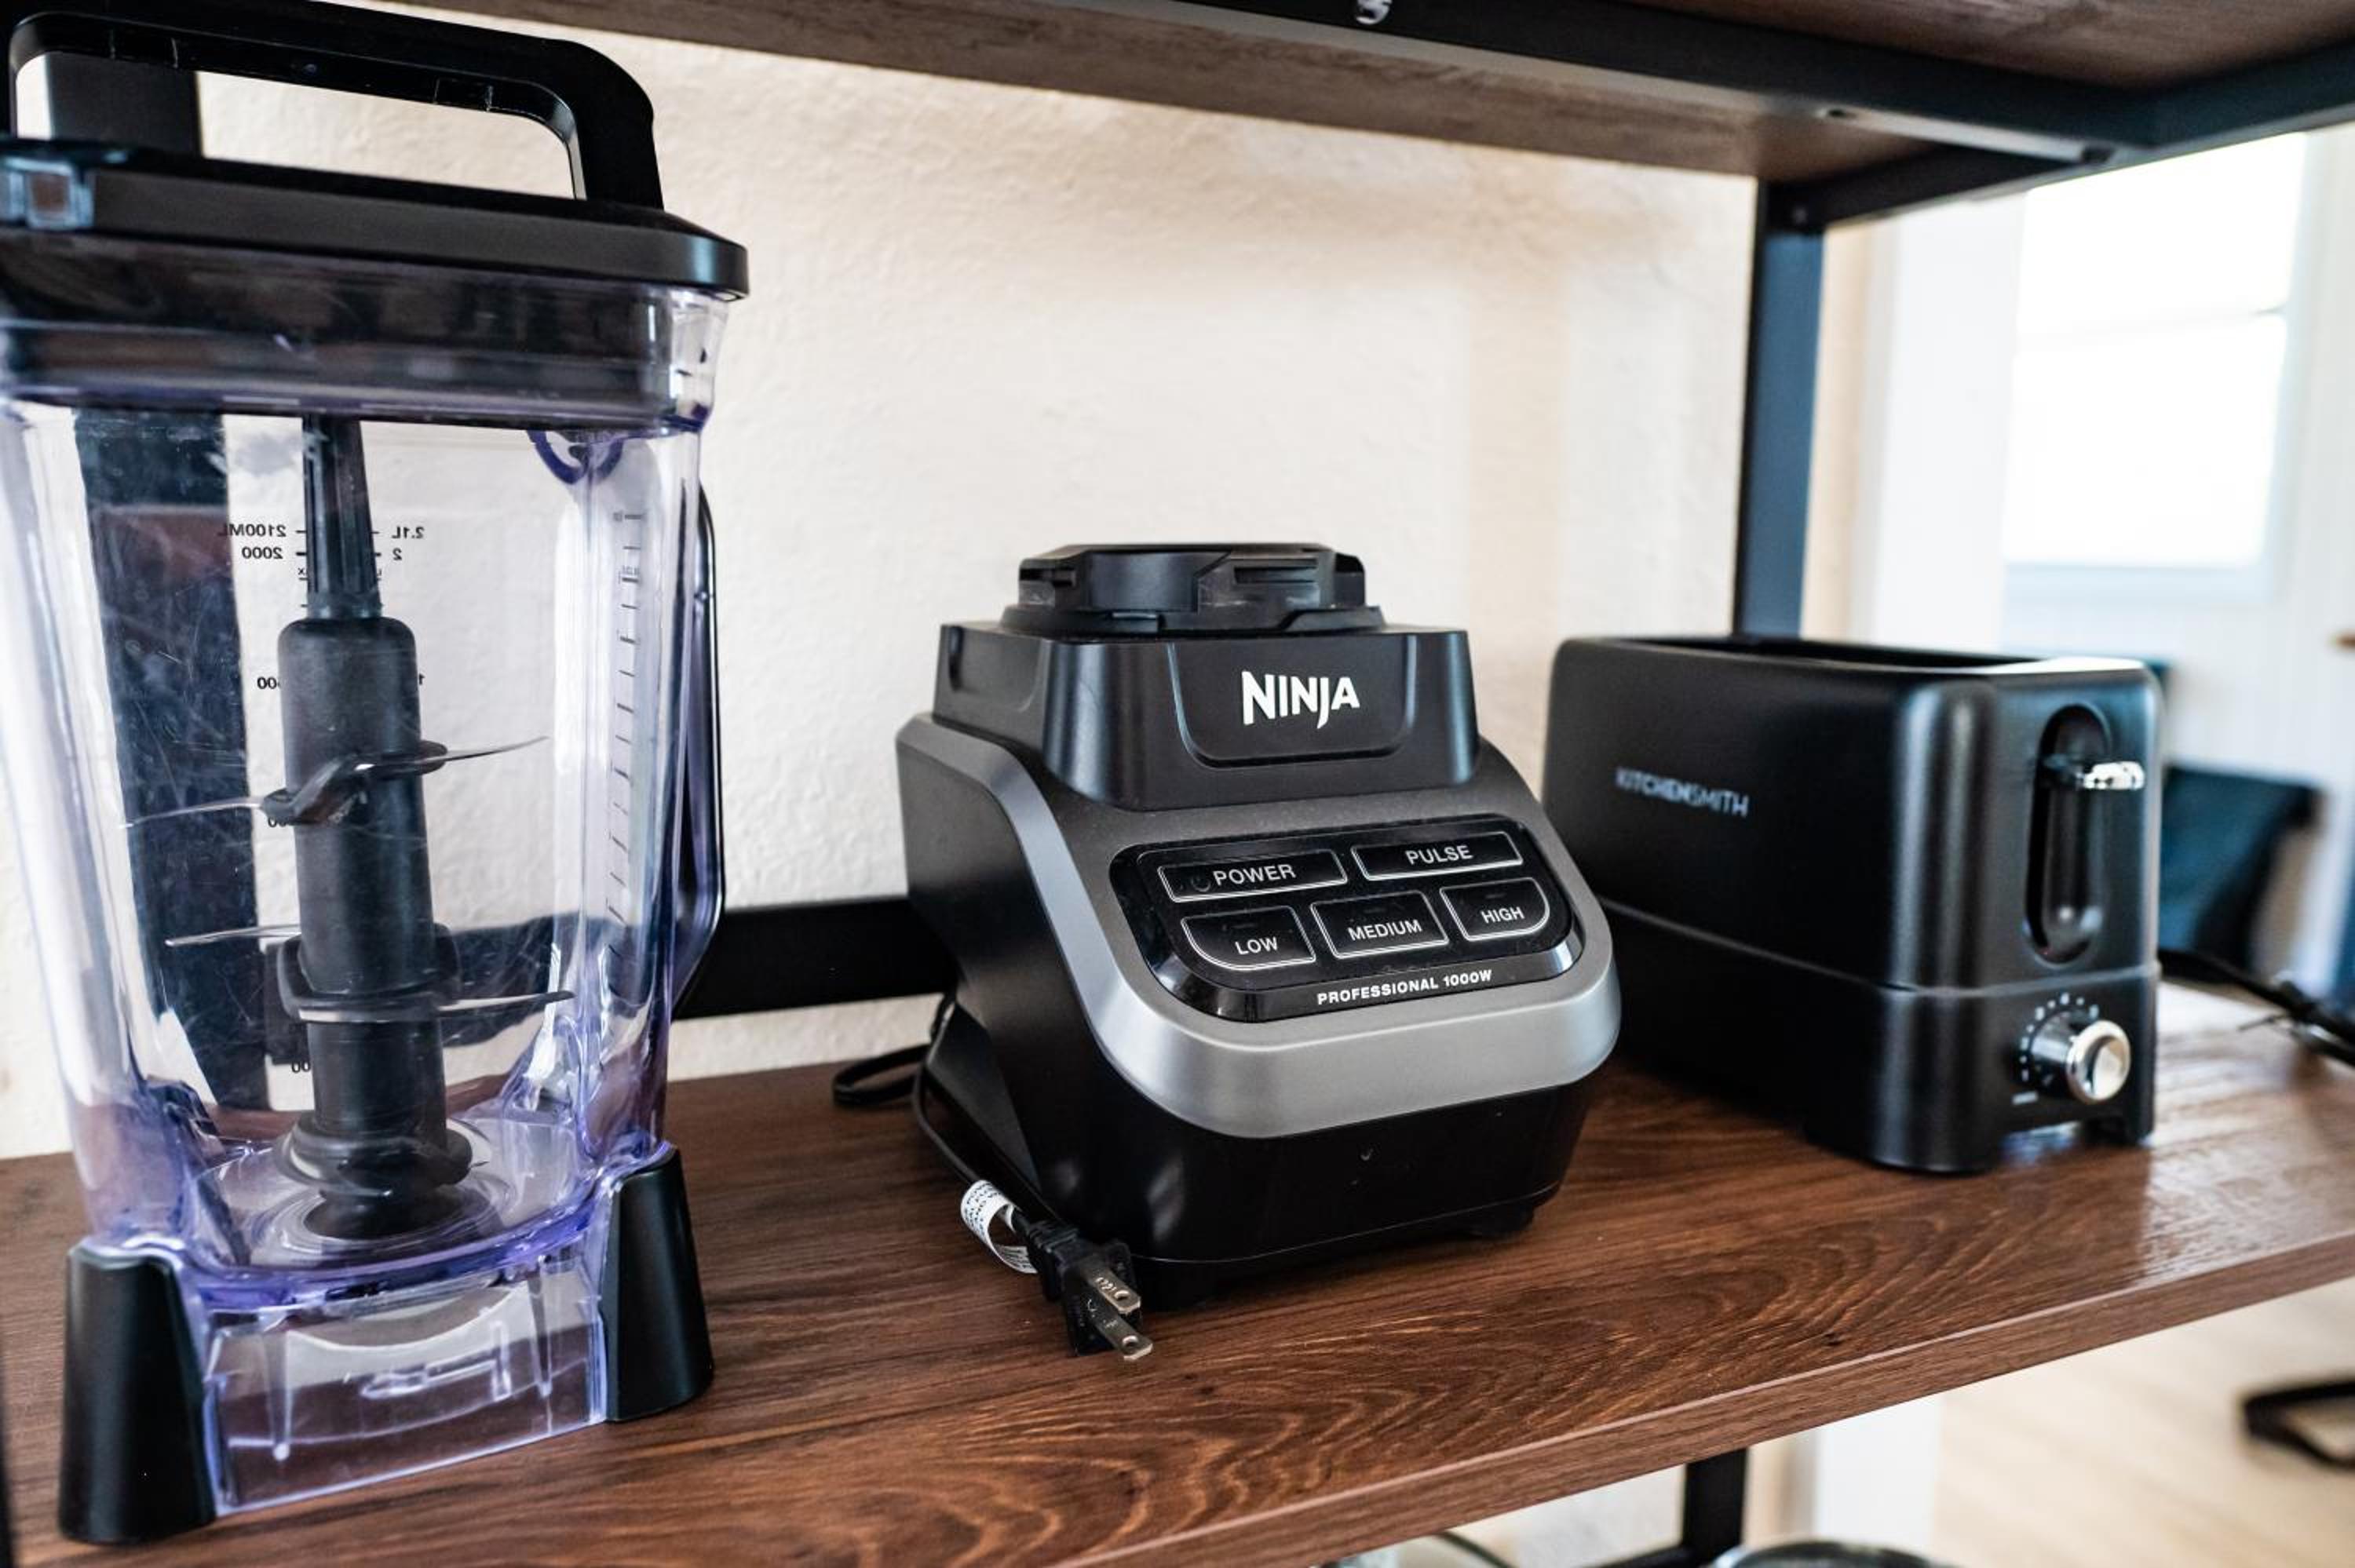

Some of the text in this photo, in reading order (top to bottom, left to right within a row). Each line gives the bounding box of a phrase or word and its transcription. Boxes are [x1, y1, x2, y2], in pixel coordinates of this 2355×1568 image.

[1241, 670, 1360, 729] NINJA
[1404, 844, 1473, 865] PULSE
[1212, 863, 1297, 886] POWER
[1480, 906, 1525, 924] HIGH
[1347, 918, 1423, 941] MEDIUM
[1235, 936, 1280, 955] LOW
[1316, 969, 1492, 1005] PROFESSIONAL 1000W
